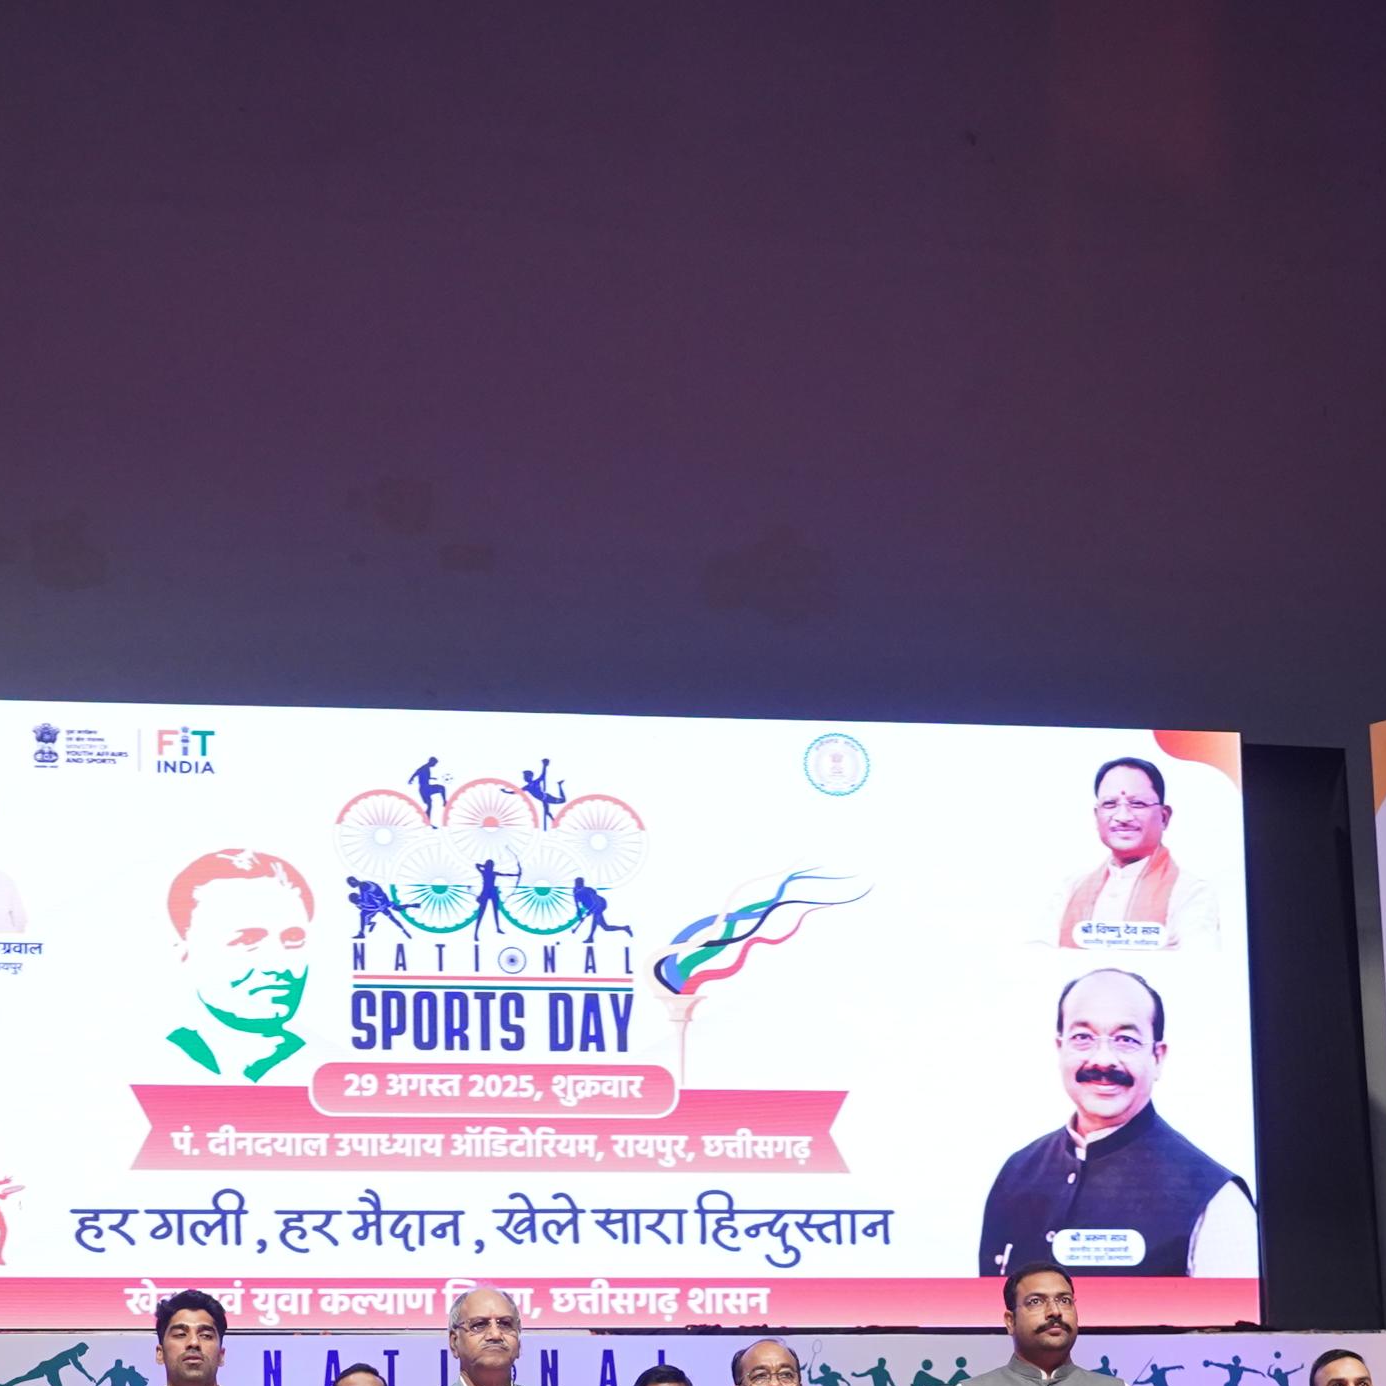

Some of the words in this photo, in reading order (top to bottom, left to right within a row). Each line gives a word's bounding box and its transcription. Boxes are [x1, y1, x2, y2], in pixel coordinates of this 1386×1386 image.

[157, 760, 215, 774] INDIA
[351, 990, 525, 1051] SPORTS
[549, 992, 634, 1052] DAY
[343, 1074, 378, 1098] 29
[385, 1073, 463, 1099] अगस्त
[468, 1074, 543, 1102] 2025,
[551, 1074, 645, 1107] शुक्रवार
[170, 1125, 200, 1157] पं.
[207, 1124, 328, 1157] दीनदयाल
[334, 1130, 444, 1158] उपाध्याय
[450, 1126, 604, 1162] ऑडिटोरियम,
[610, 1134, 696, 1167] रायपुर,
[701, 1127, 814, 1165] छत्तीसगढ़
[70, 1208, 139, 1253] हर
[274, 1209, 343, 1254] हर
[492, 1192, 586, 1245] खेले
[590, 1208, 688, 1245] सारा
[694, 1189, 894, 1268] हिन्दुस्तान
[251, 1286, 313, 1326] युवा
[318, 1286, 437, 1316] कल्याण
[549, 1278, 681, 1326] छत्तीसगढ़
[687, 1286, 770, 1315] शासन
